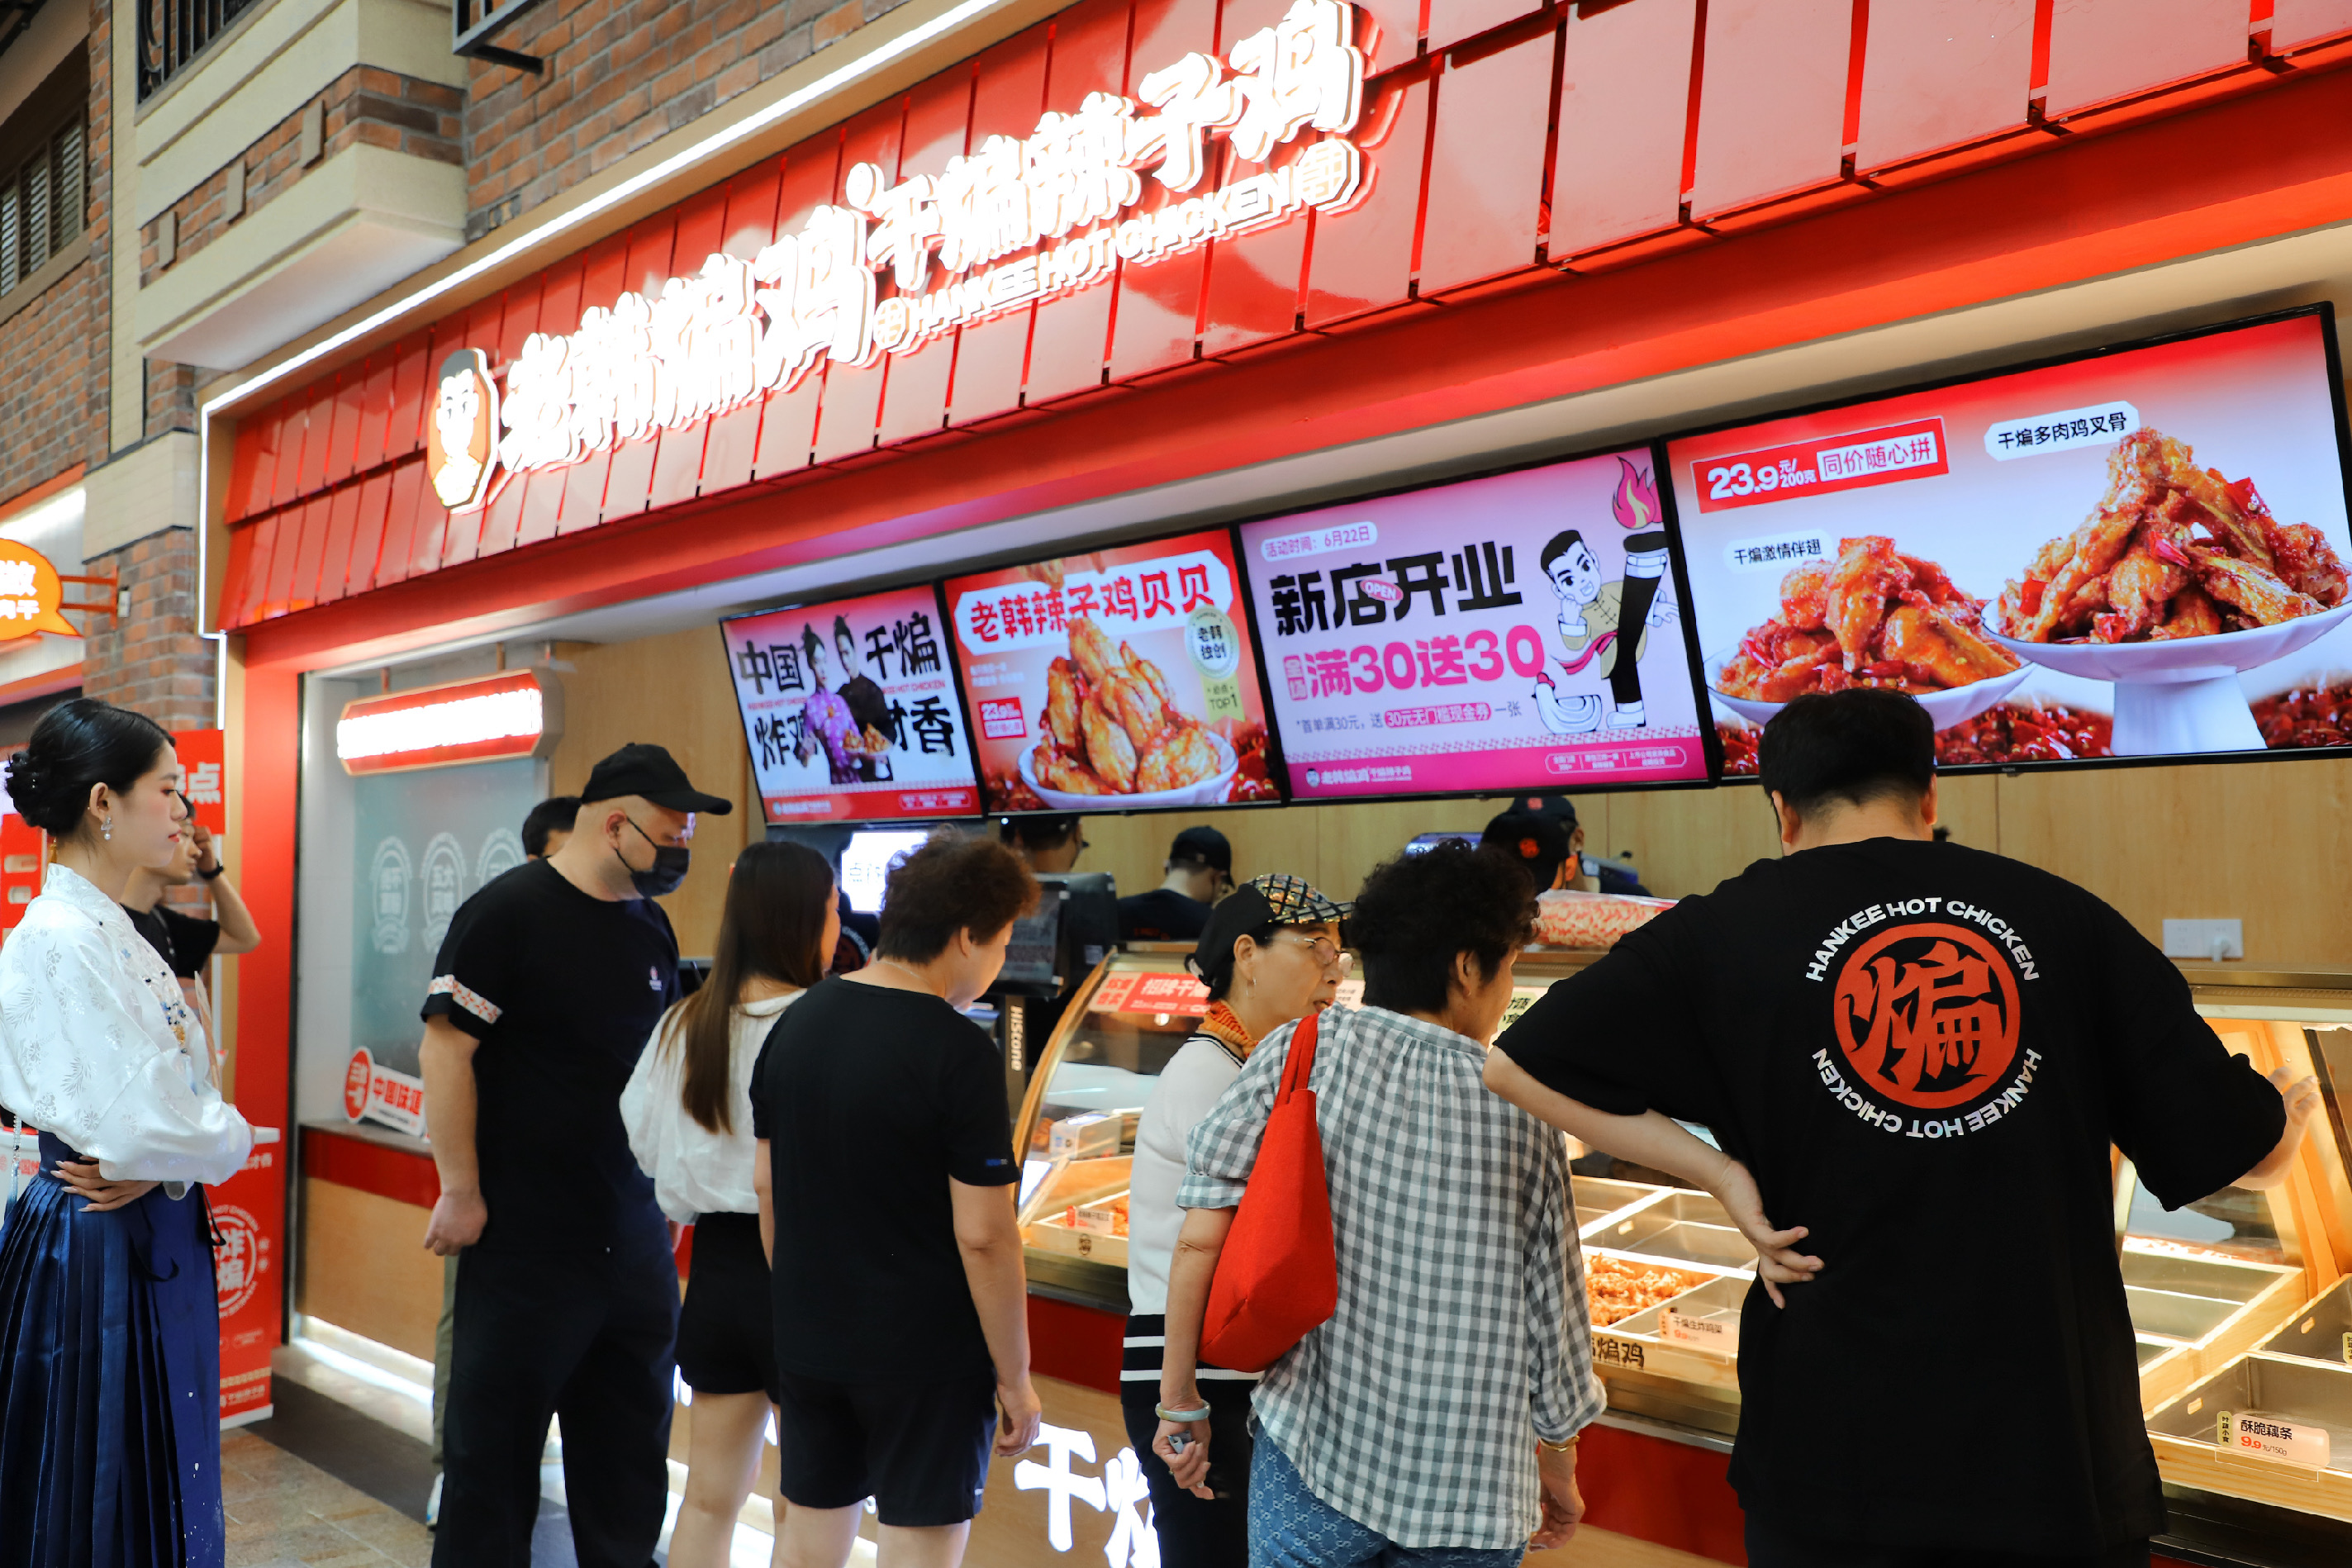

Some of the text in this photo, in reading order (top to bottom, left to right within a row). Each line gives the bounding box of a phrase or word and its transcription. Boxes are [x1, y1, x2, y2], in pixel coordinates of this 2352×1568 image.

[911, 255, 1038, 334] HANKEE
[1039, 228, 1115, 287] HOT
[1116, 165, 1300, 262] CHICKEN
[1822, 436, 1931, 478] 同价随心拼
[1997, 411, 2128, 451] 干煸多肉鸡叉骨
[1707, 462, 1779, 501] 23.9
[969, 564, 1214, 644] 老韩辣子鸡贝贝
[1269, 541, 1523, 636] 新店开业
[1364, 582, 1398, 601] OPEN
[737, 639, 805, 695] 中国
[865, 611, 941, 680] 干煸
[1304, 625, 1545, 698] 满30送30
[1805, 896, 2041, 982] HANKEE HOT CHICKEN
[1812, 1048, 2043, 1139] HANKEE HOT CHICKEN
[1592, 1337, 1645, 1370] 煸鸡
[2240, 1419, 2293, 1440] 酥脆藕条
[2240, 1436, 2262, 1449] 9.9
